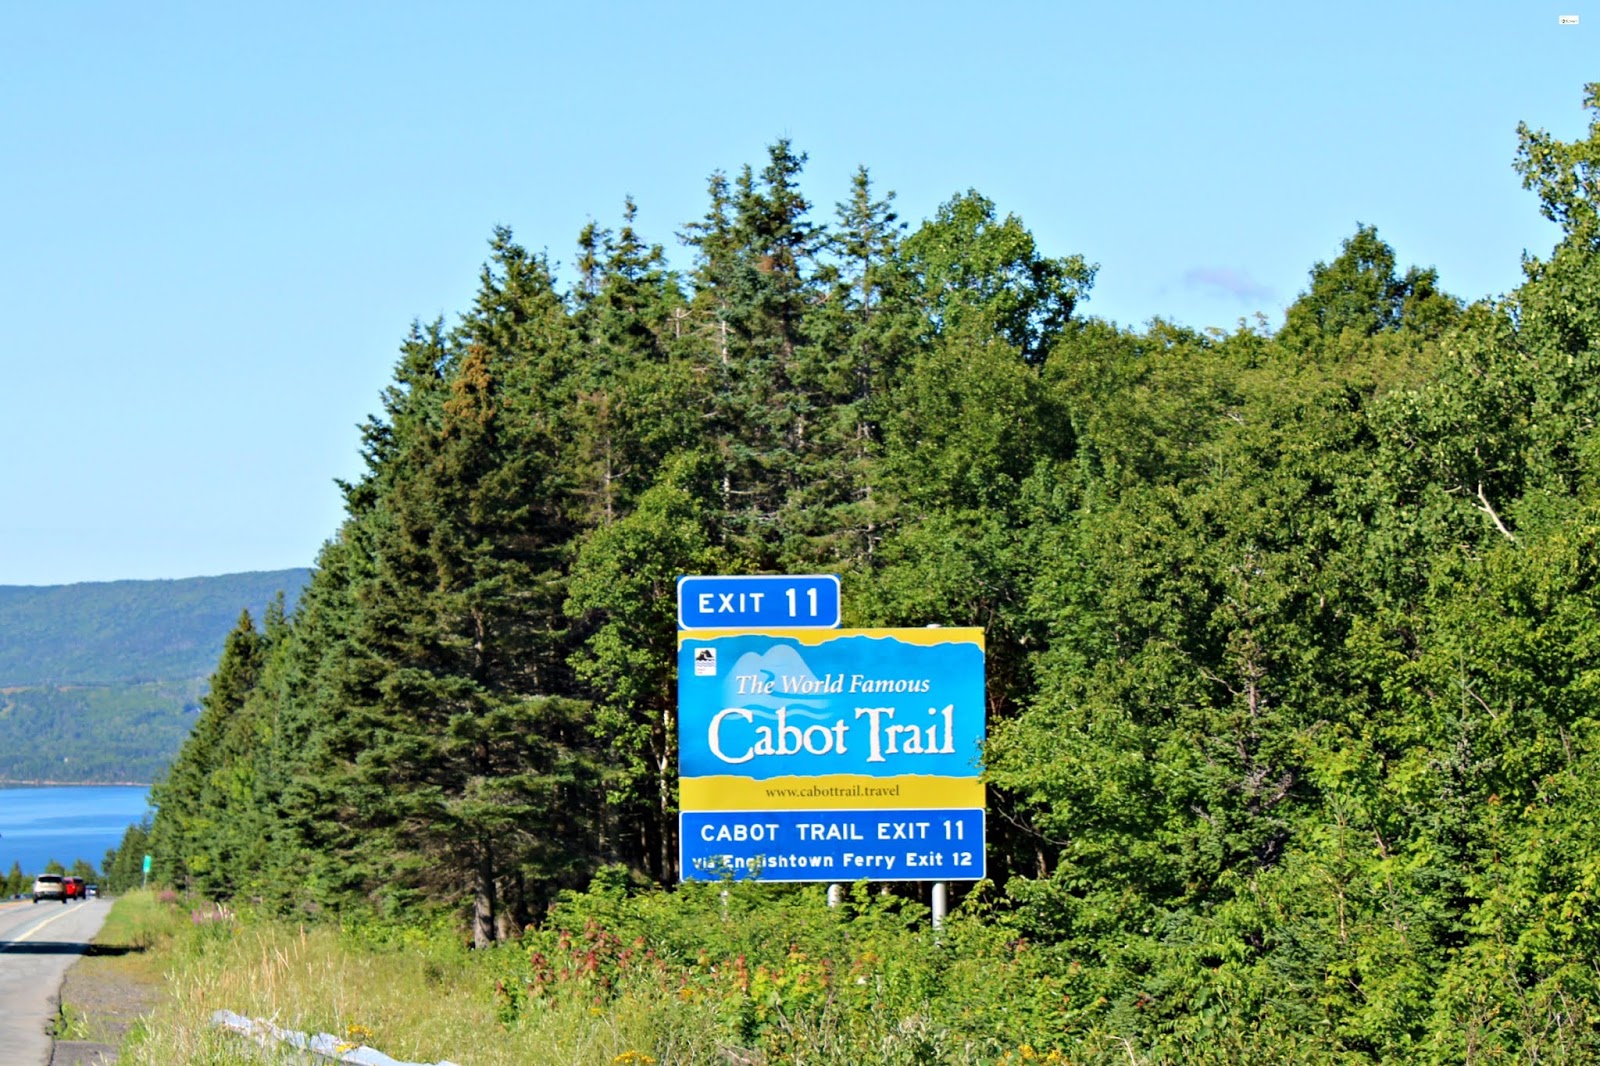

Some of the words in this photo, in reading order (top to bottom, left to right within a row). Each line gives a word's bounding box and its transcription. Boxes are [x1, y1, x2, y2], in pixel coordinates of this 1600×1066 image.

[698, 592, 765, 614] EXIT
[785, 587, 818, 617] 11
[735, 674, 774, 694] The
[782, 673, 844, 694] World
[848, 674, 931, 693] Famous
[708, 706, 850, 764] Cabot
[854, 704, 956, 763] Trail
[765, 784, 901, 798] www.cabottrail.travel
[700, 823, 780, 843] CABOT
[796, 823, 864, 841] TRAIL
[877, 822, 931, 840] EXIT
[943, 820, 964, 840] 11
[843, 853, 896, 869] Ferry
[906, 852, 943, 868] Exit
[952, 852, 973, 867] 12
